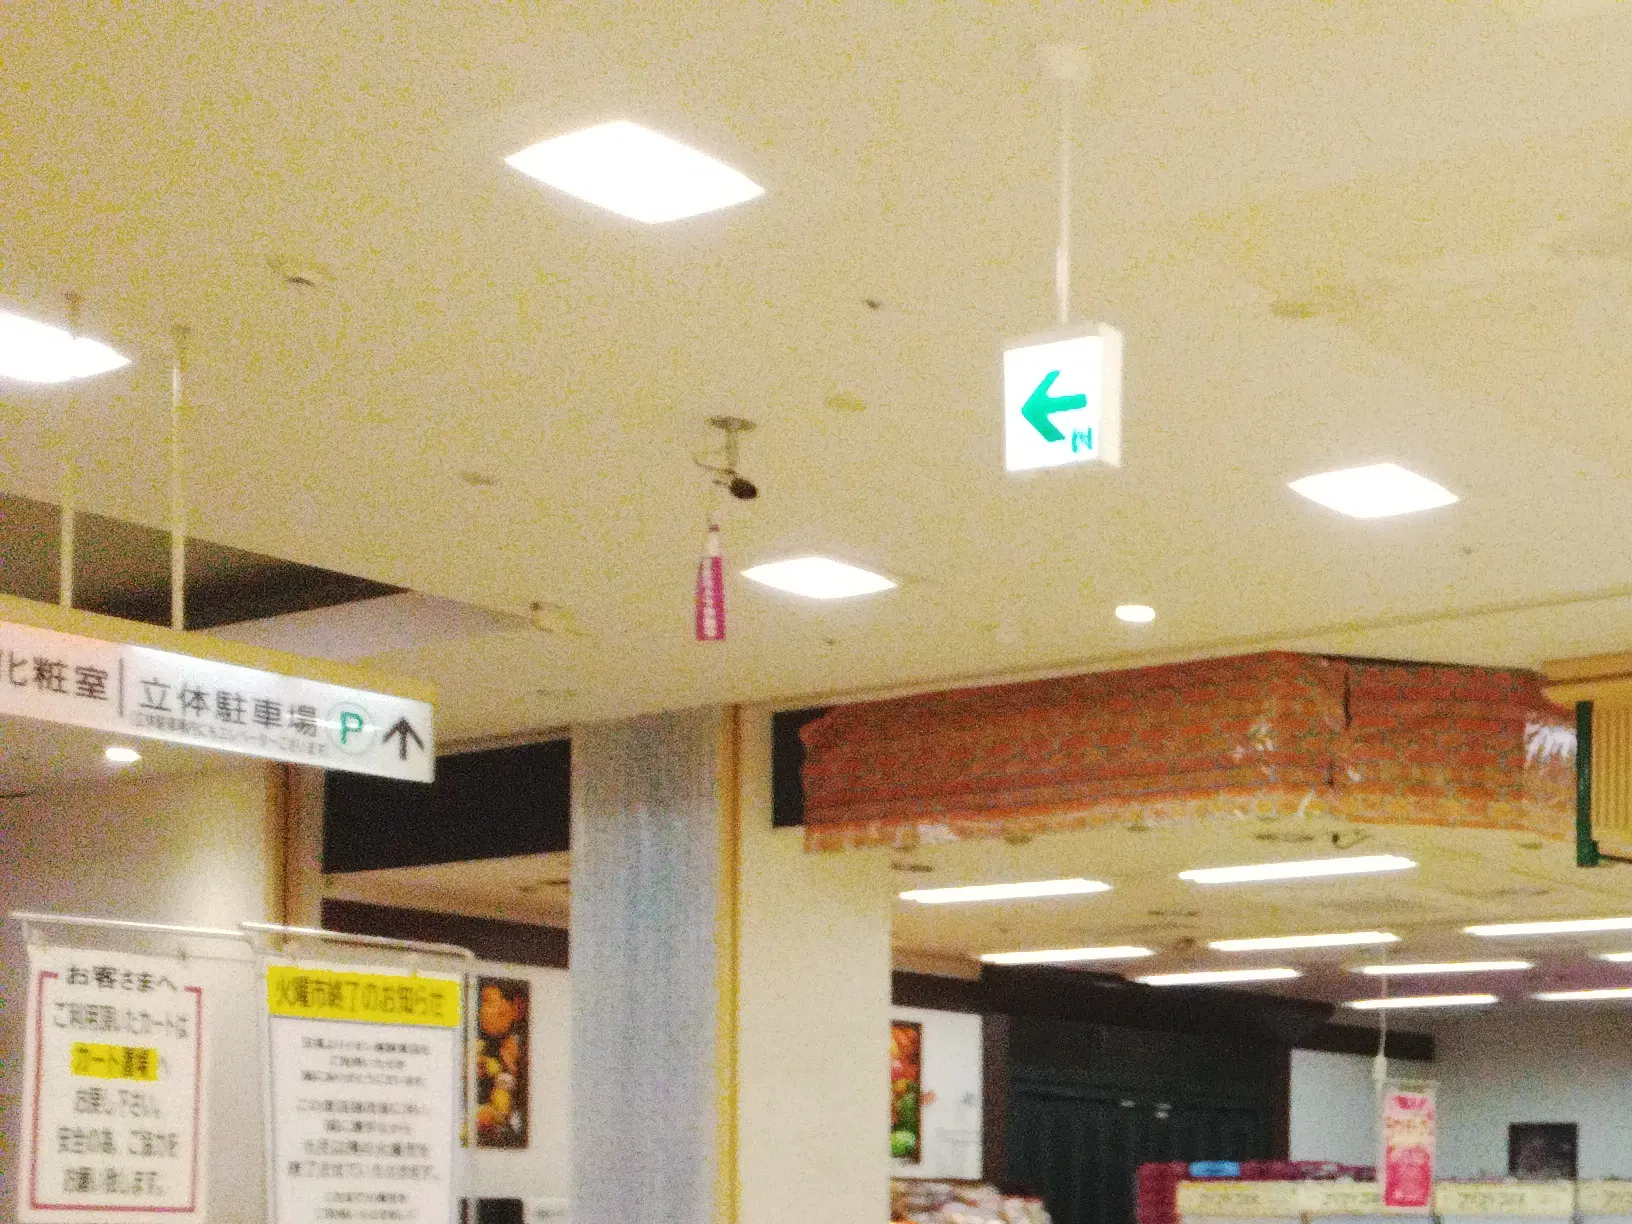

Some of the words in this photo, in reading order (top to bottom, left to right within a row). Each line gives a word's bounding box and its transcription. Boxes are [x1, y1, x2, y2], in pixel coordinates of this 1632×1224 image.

[140, 676, 318, 738] 立体駐車場
[339, 711, 364, 744] P
[67, 964, 178, 993] お客さまへ
